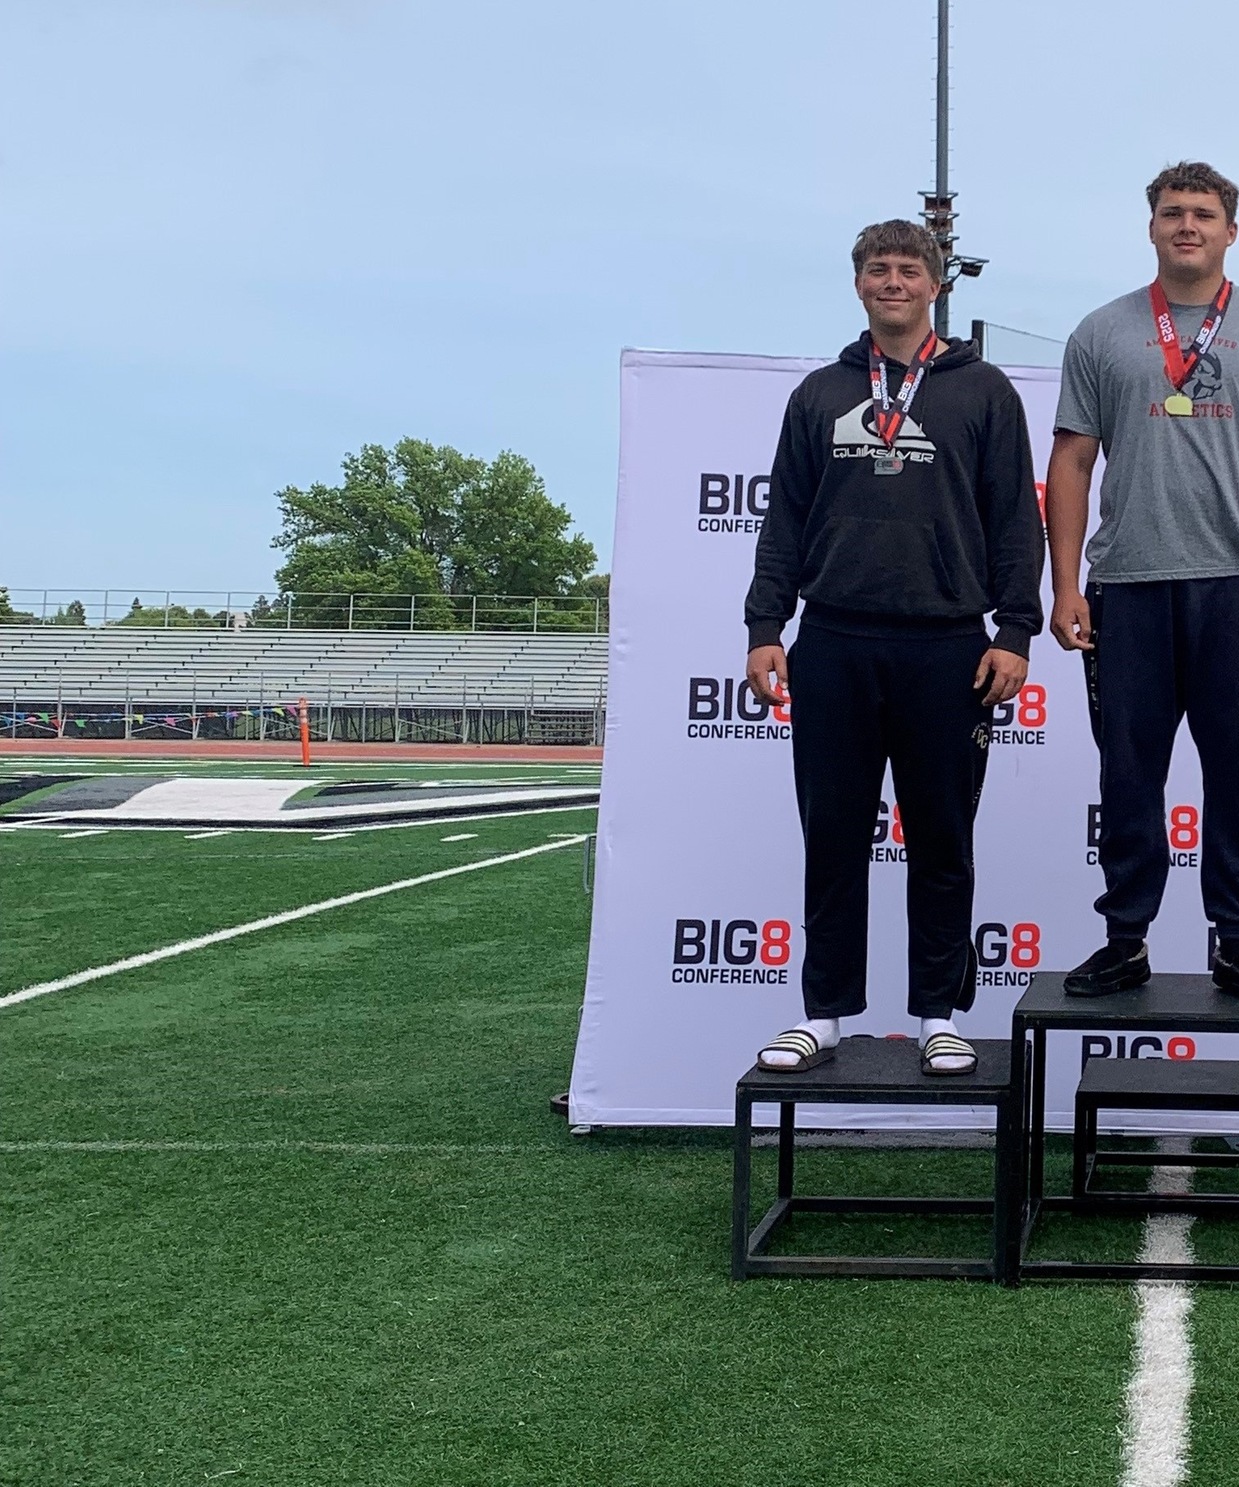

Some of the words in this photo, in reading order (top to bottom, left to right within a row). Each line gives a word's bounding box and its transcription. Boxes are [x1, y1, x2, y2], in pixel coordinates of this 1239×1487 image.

[1158, 312, 1175, 343] 2025
[1196, 318, 1214, 345] BIG8
[871, 371, 882, 399] BIG8
[897, 372, 916, 401] BIG8
[699, 473, 771, 516] BIG
[687, 724, 792, 740] CONFERENC
[990, 730, 1045, 745] RENCE
[673, 919, 791, 966] BIG8
[975, 923, 1041, 968] G8
[671, 968, 788, 985] CONFERENCE
